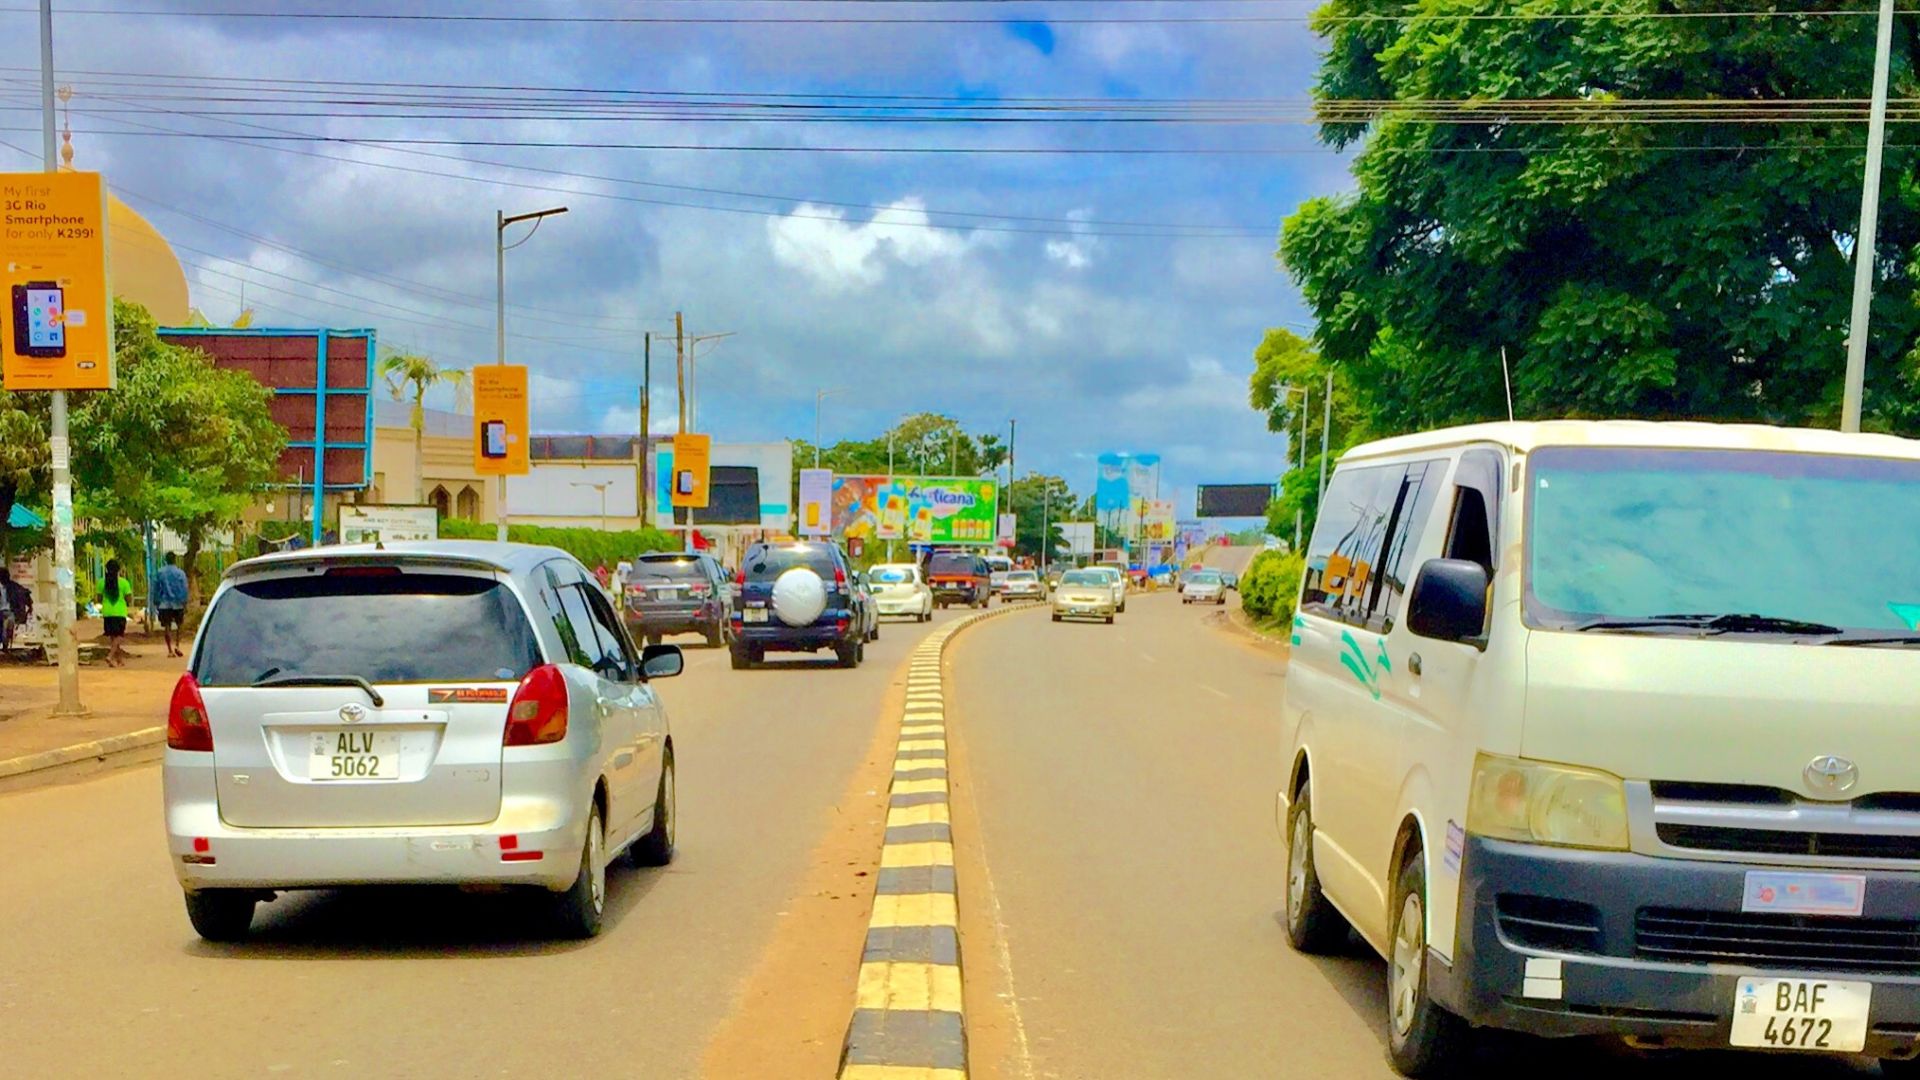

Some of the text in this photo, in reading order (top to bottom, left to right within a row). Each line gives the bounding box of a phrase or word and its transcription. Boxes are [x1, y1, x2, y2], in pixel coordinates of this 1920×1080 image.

[4, 186, 51, 197] My first
[25, 200, 46, 211] Rio
[5, 214, 84, 227] Smartphone
[6, 228, 94, 240] for only K299!
[337, 732, 374, 754] ALV
[331, 755, 380, 777] 5062
[1775, 981, 1828, 1013] BAF
[1763, 1016, 1833, 1047] 4672
